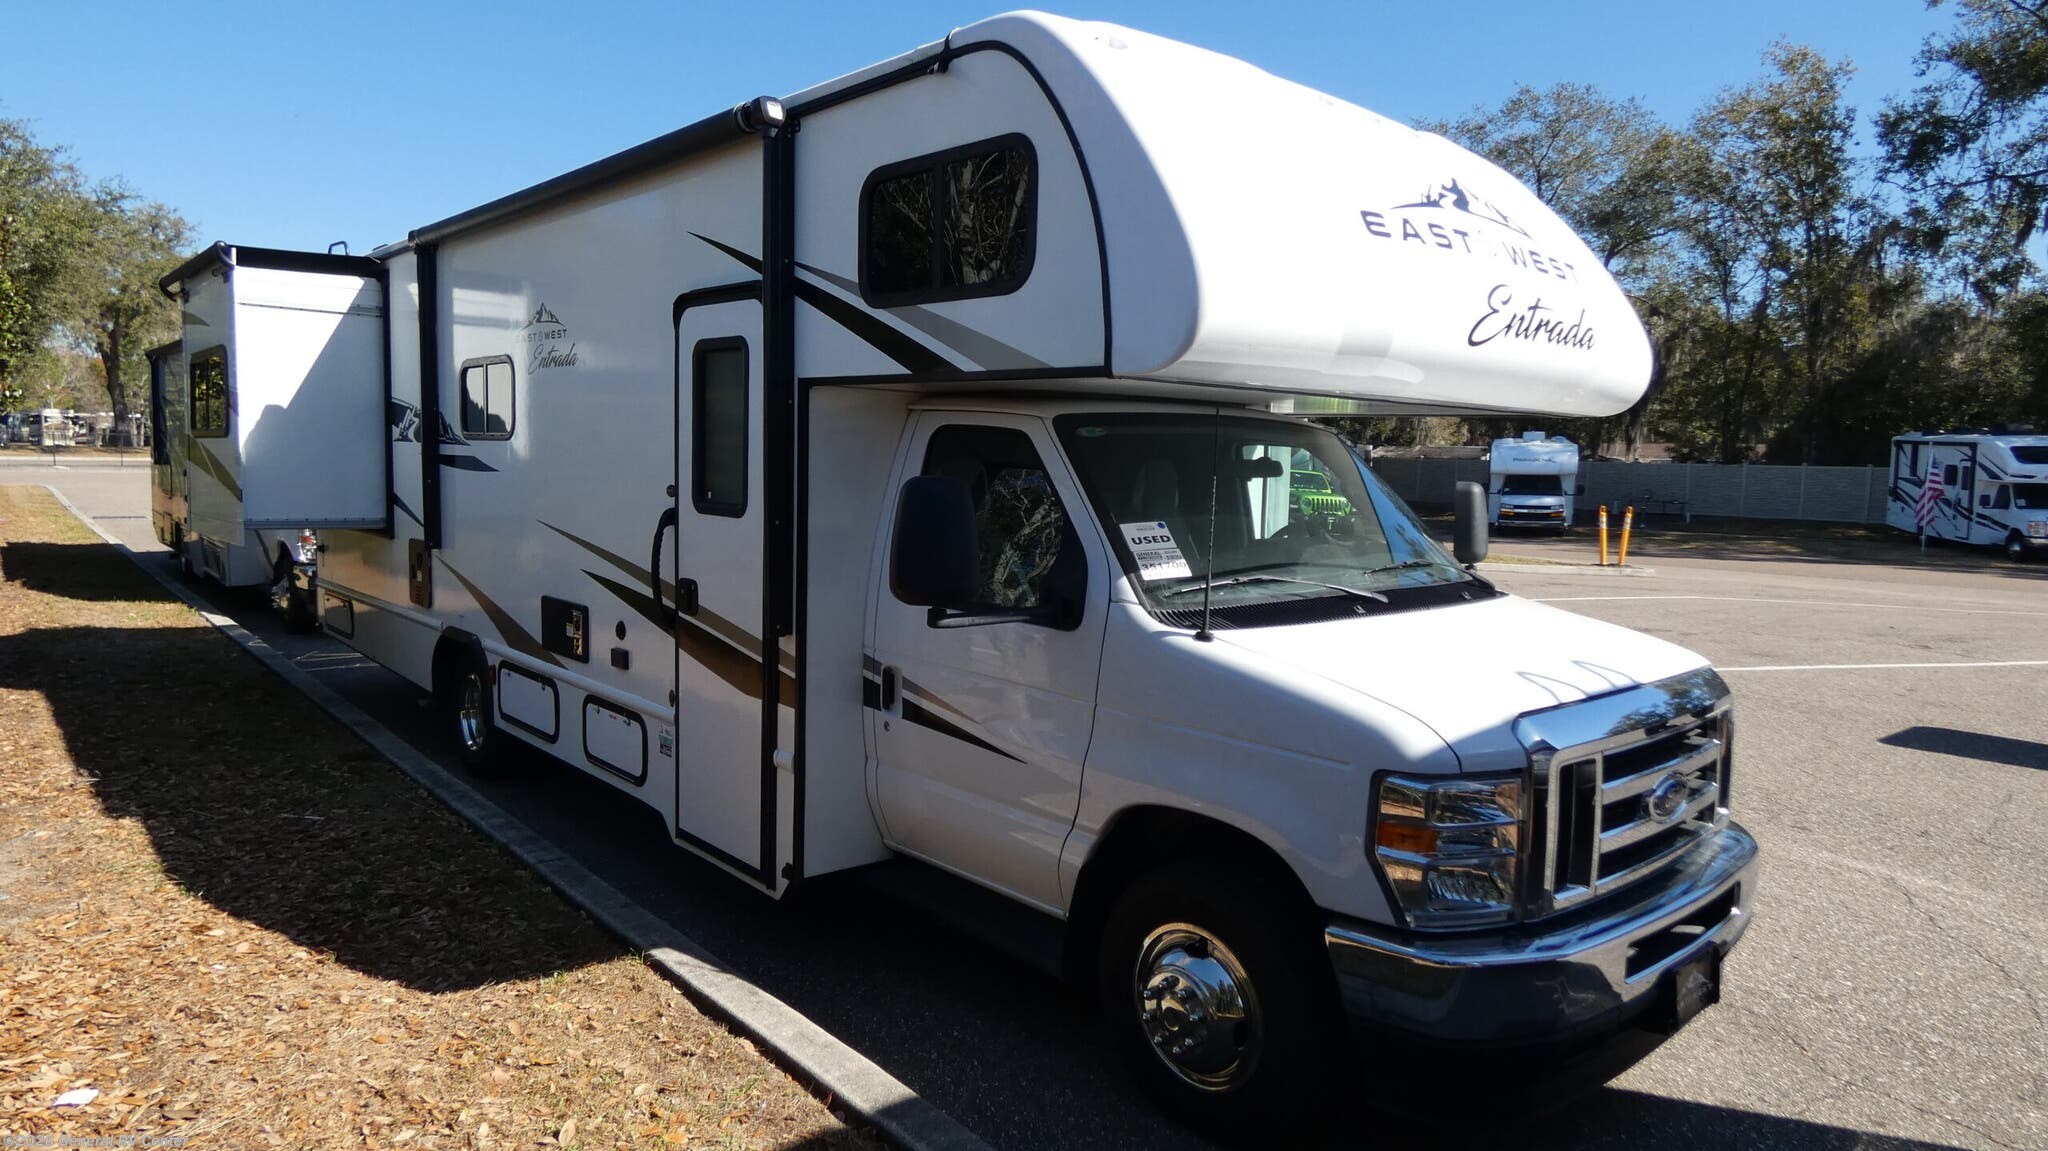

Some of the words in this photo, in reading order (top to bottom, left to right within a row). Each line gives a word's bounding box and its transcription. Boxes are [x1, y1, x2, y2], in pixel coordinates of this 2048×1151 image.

[1360, 210, 1471, 254] EAST
[1502, 242, 1578, 283] WEST
[1467, 284, 1595, 350] Entrada
[544, 329, 567, 340] WEST
[527, 343, 577, 374] Entrada
[1131, 535, 1171, 545] USED
